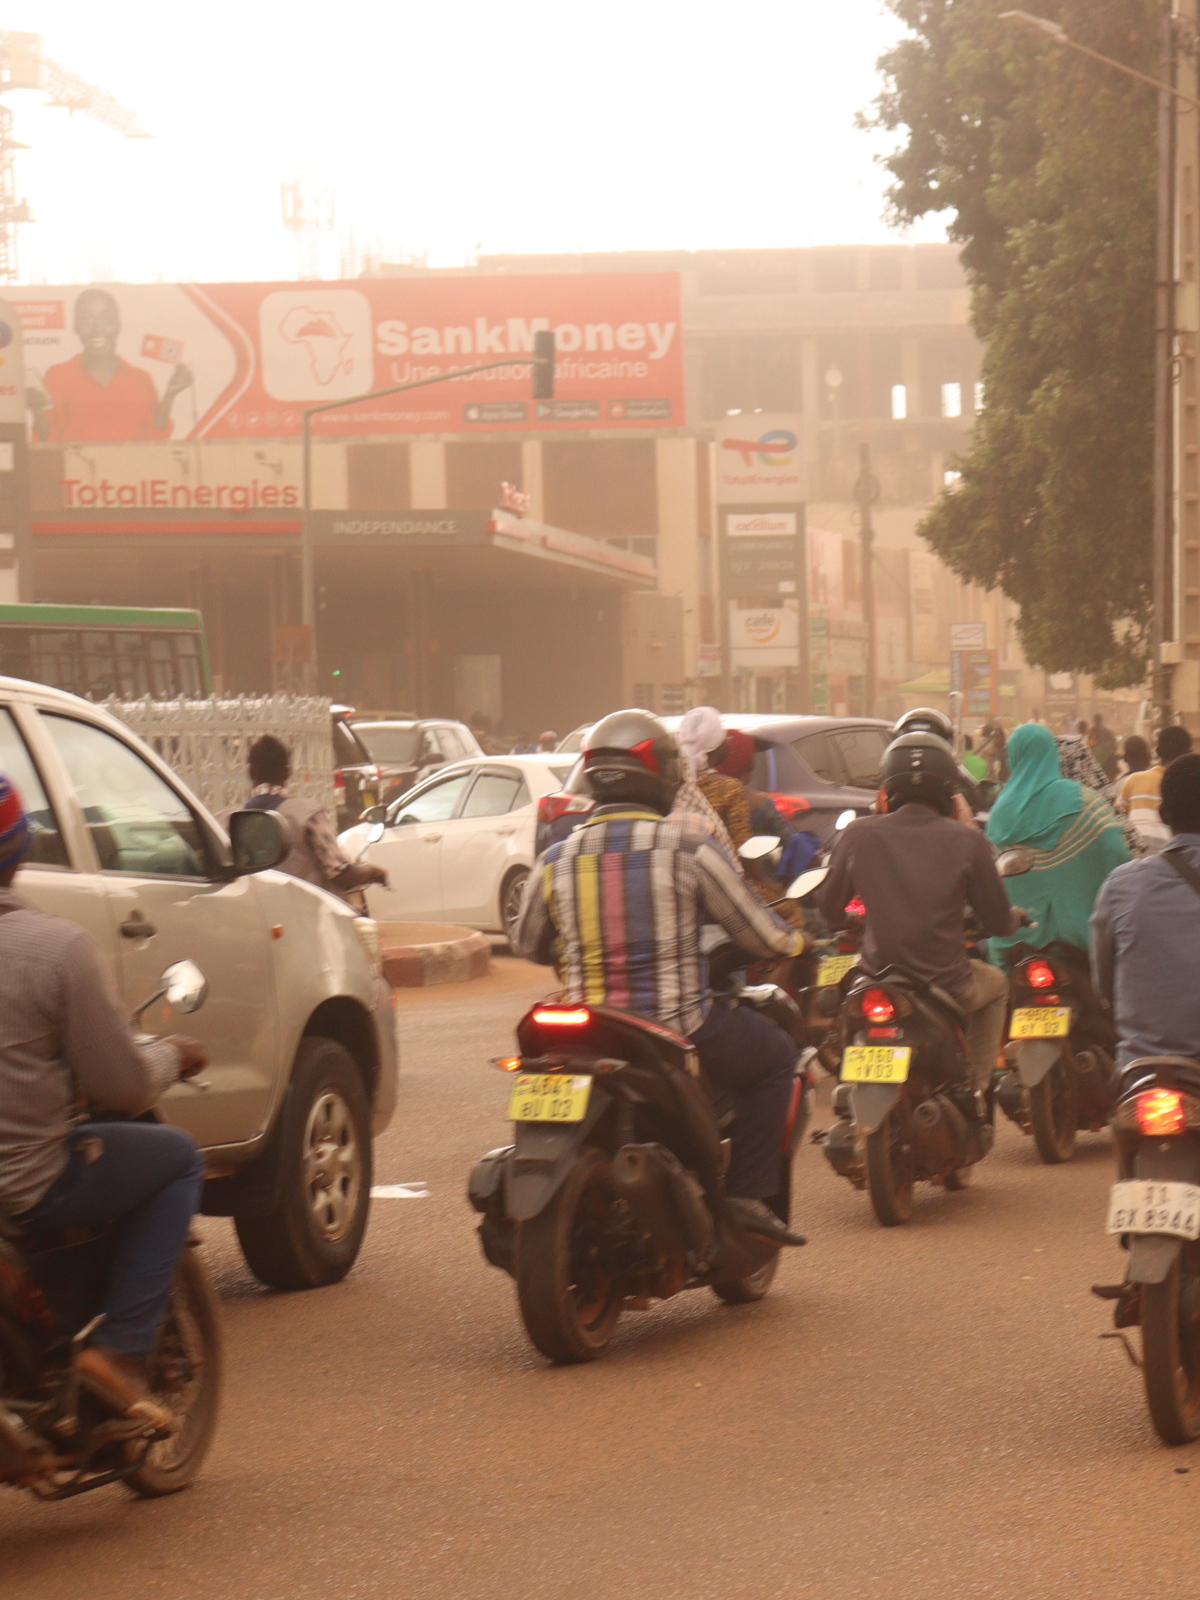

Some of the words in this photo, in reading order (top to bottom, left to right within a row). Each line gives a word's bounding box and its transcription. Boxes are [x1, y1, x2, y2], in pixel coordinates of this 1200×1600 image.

[376, 316, 676, 360] SankMoney
[390, 359, 441, 384] Une
[448, 355, 535, 381] solution
[553, 353, 648, 379] africaine
[59, 480, 300, 513] TotalEnergies
[332, 519, 457, 535] INDEPENDANCE
